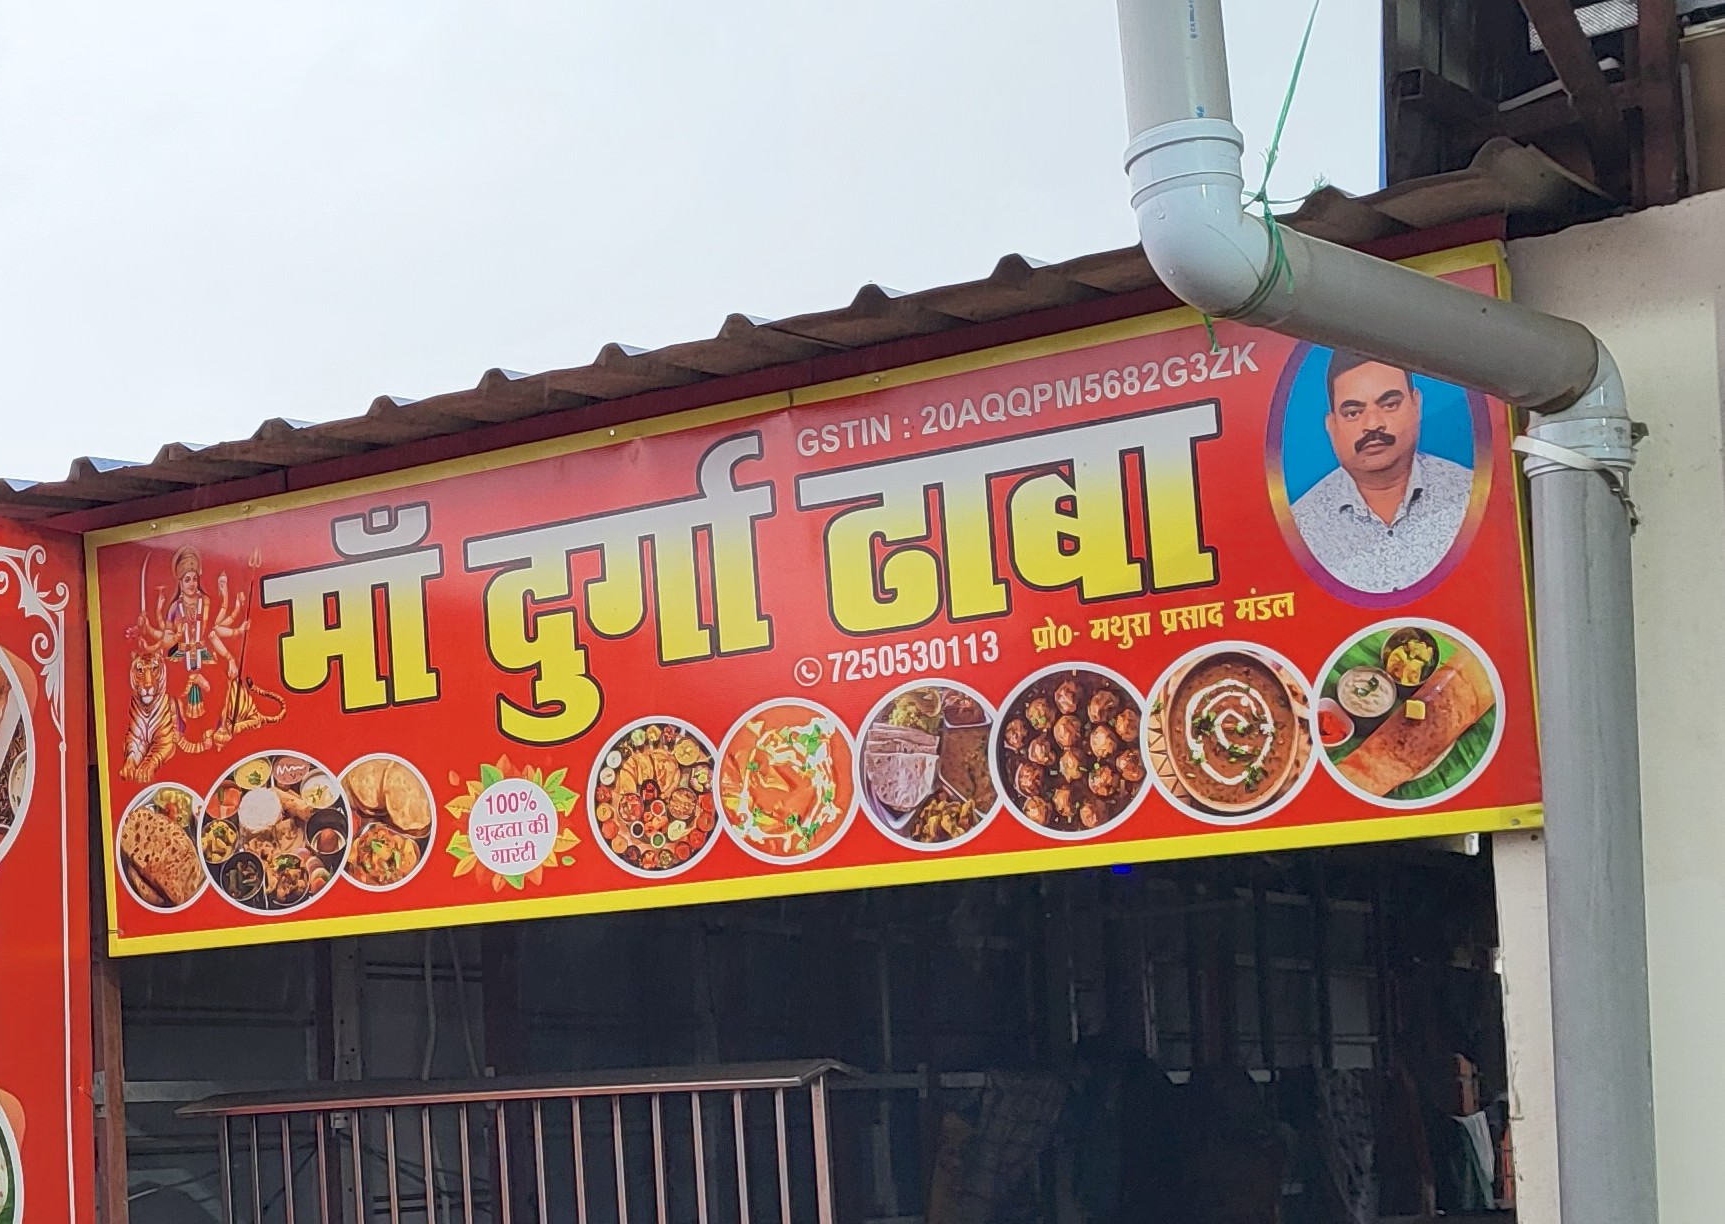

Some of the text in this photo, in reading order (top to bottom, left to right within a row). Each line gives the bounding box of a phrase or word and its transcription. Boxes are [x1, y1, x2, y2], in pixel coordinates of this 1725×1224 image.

[796, 415, 891, 456] GSTIN
[920, 342, 1259, 436] 20AQQPM5682G3ZK
[261, 398, 1222, 747] माँ दुर्गा ढाबा
[1090, 612, 1150, 650] मथुरा
[1161, 601, 1224, 635] प्रसाद
[1235, 587, 1295, 622] मंडल
[828, 630, 999, 682] 7250530113
[485, 789, 537, 815] 100%
[527, 812, 550, 834] की
[490, 840, 537, 864] गारंटी
